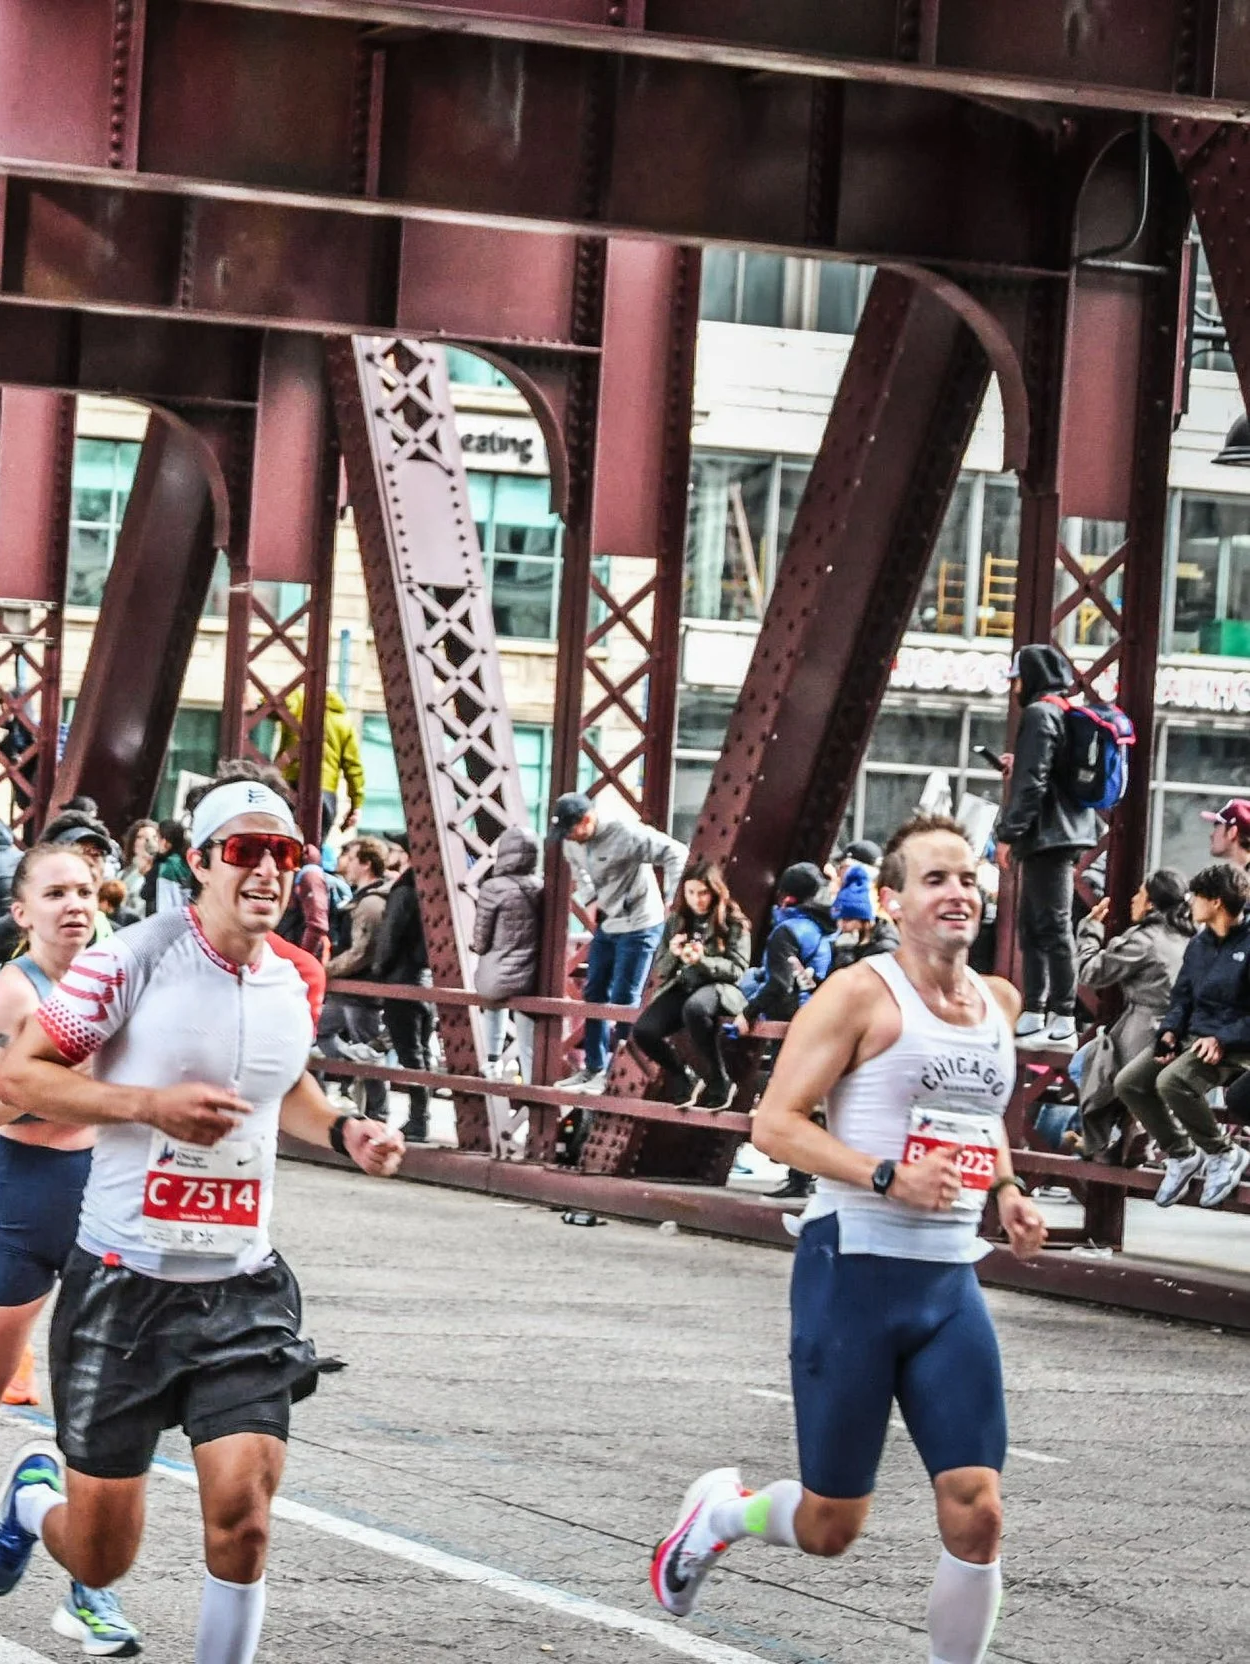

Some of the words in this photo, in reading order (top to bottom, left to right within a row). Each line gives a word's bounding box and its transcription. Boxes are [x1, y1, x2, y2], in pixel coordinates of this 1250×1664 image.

[921, 1057, 1006, 1097] CHICAGO
[148, 1177, 172, 1206] C
[179, 1180, 257, 1212] 7514
